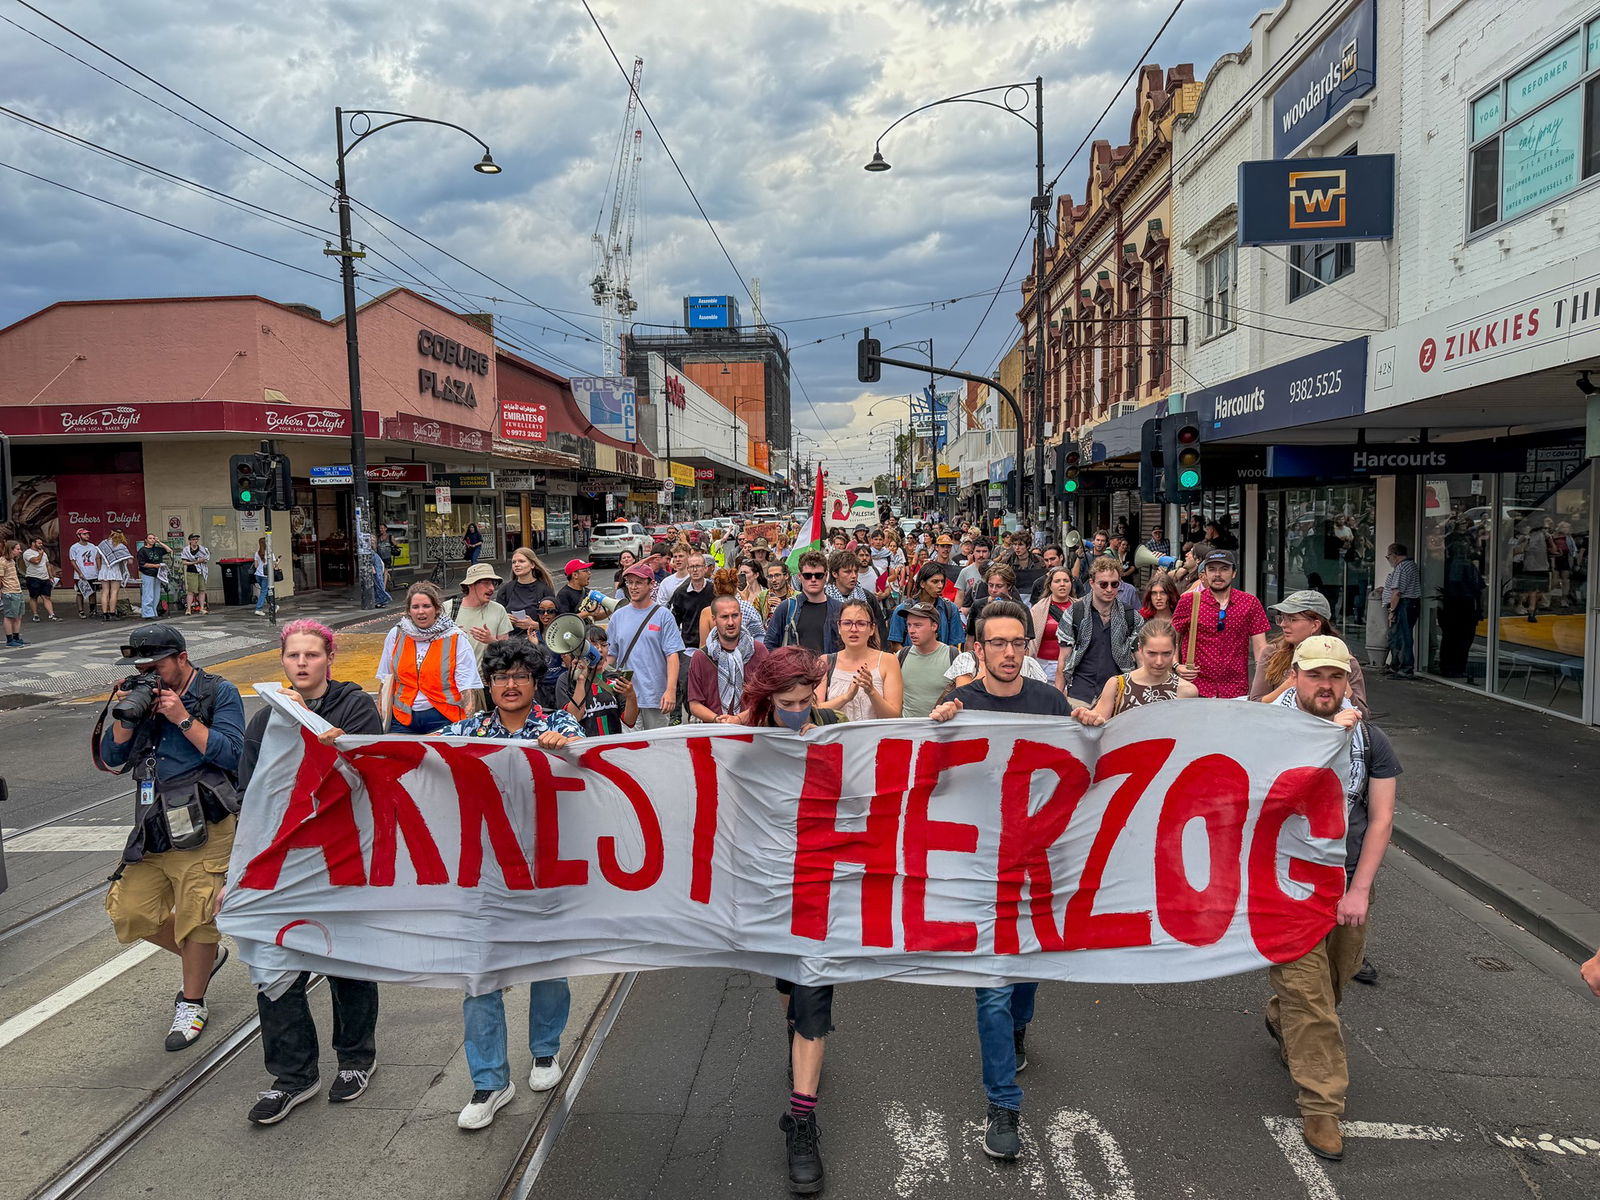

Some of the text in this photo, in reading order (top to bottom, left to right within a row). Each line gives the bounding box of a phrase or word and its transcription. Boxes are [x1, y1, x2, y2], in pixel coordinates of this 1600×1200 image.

[1521, 60, 1568, 97] REFORMER
[1283, 61, 1341, 134] woodards
[1479, 106, 1499, 124] YOGA
[1520, 146, 1560, 171] PILATES
[1506, 152, 1575, 193] REFORMER PILATES STUDIO
[1505, 198, 1522, 212] ENTER
[1523, 189, 1538, 204] FROM
[1539, 180, 1563, 198] RUSSELL
[1444, 308, 1540, 362] ZIKKIES
[418, 329, 489, 376] COBURG
[1377, 360, 1392, 376] 428
[418, 368, 478, 409] PLAZA
[573, 378, 633, 392] FOLEYS
[1214, 369, 1343, 420] Harcourts 9382 5525
[60, 411, 141, 432] Bakers Delight
[265, 411, 345, 432] Bakers Delight
[503, 411, 538, 423] EMIRATES
[505, 421, 543, 429] JEWELLERYS
[511, 429, 527, 437] 9973
[1353, 451, 1446, 467] Harcourts
[381, 468, 408, 478] Delight
[1104, 475, 1137, 485] Taste
[68, 511, 142, 528] Bakers Delight
[239, 725, 1347, 964] ARREST HERZOG
